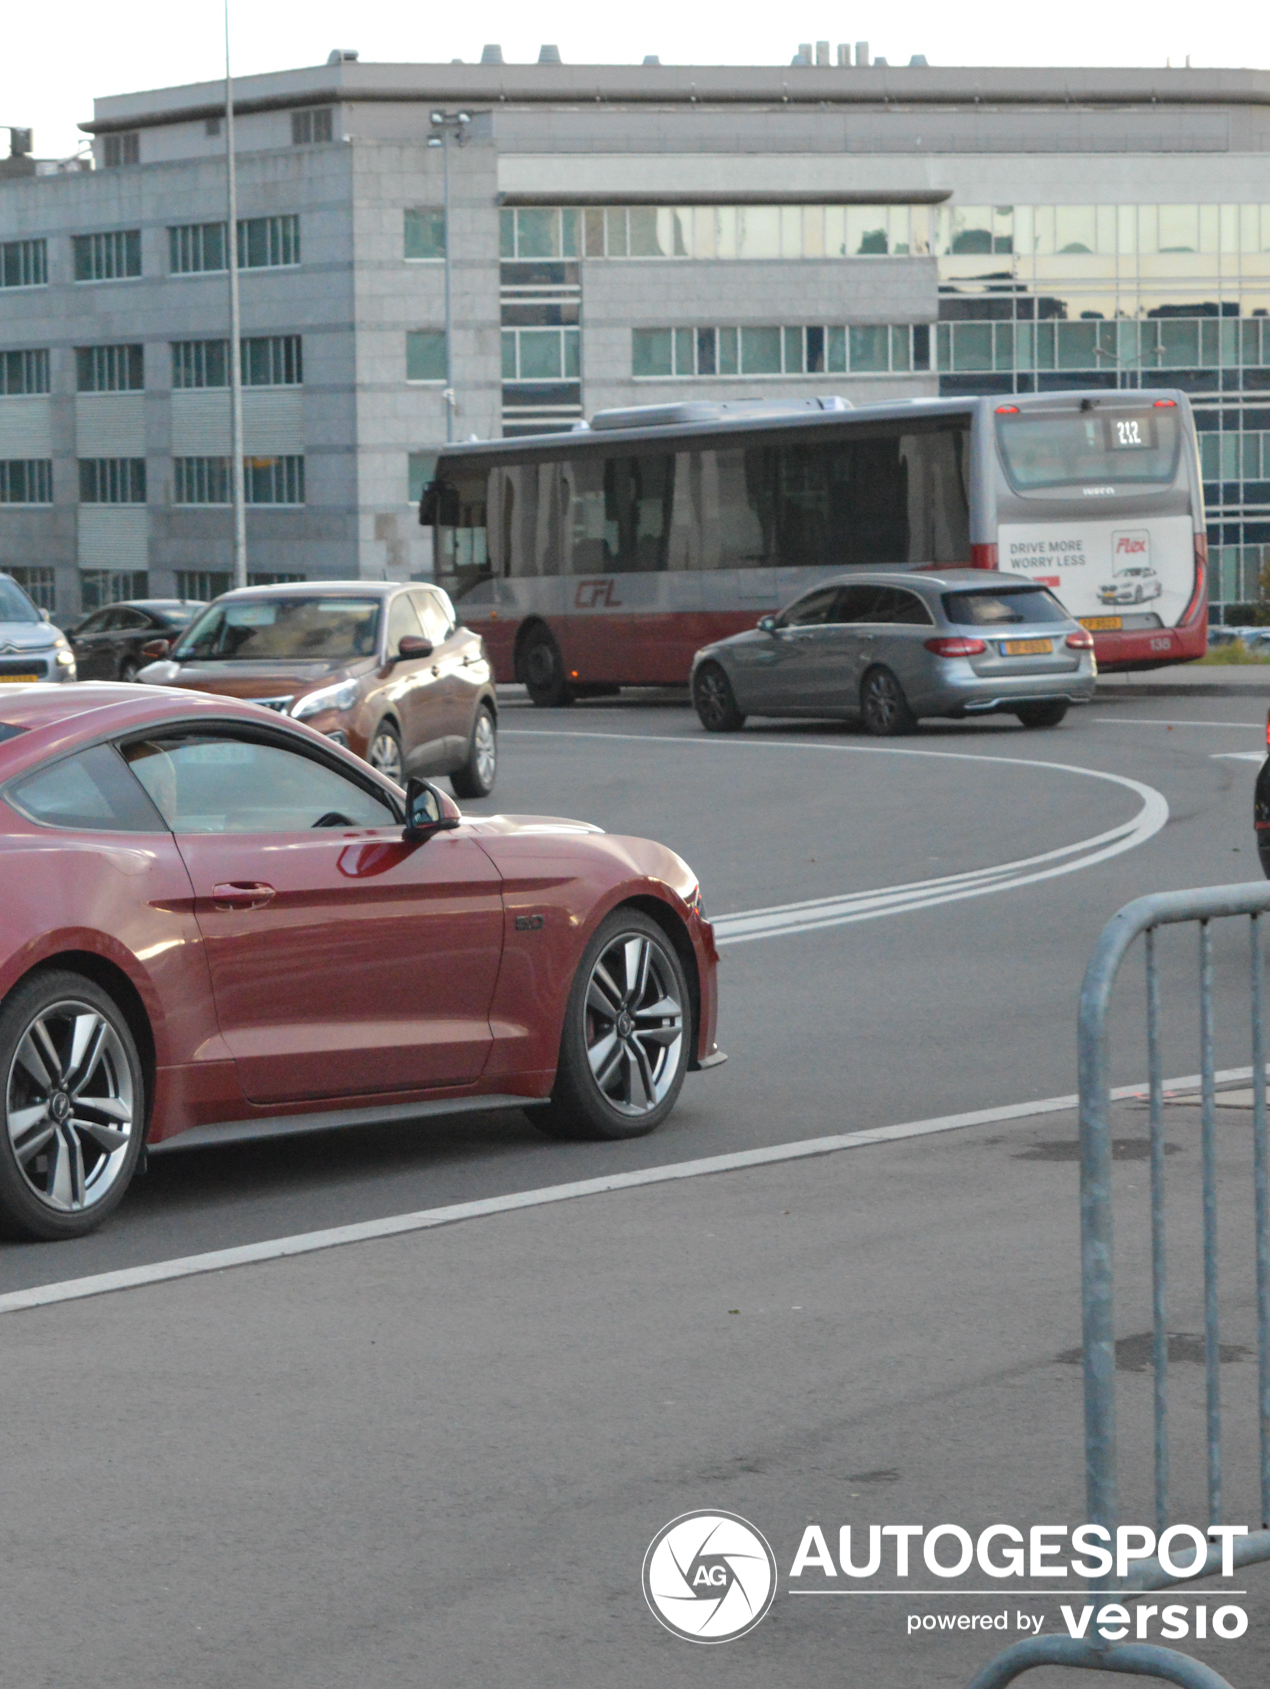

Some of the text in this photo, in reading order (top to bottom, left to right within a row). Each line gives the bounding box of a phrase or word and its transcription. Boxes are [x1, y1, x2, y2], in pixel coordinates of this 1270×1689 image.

[1117, 421, 1142, 444] 212
[1010, 540, 1083, 554] DRIVE MORE
[1011, 555, 1086, 569] WORRY LESS
[575, 579, 622, 608] CFL
